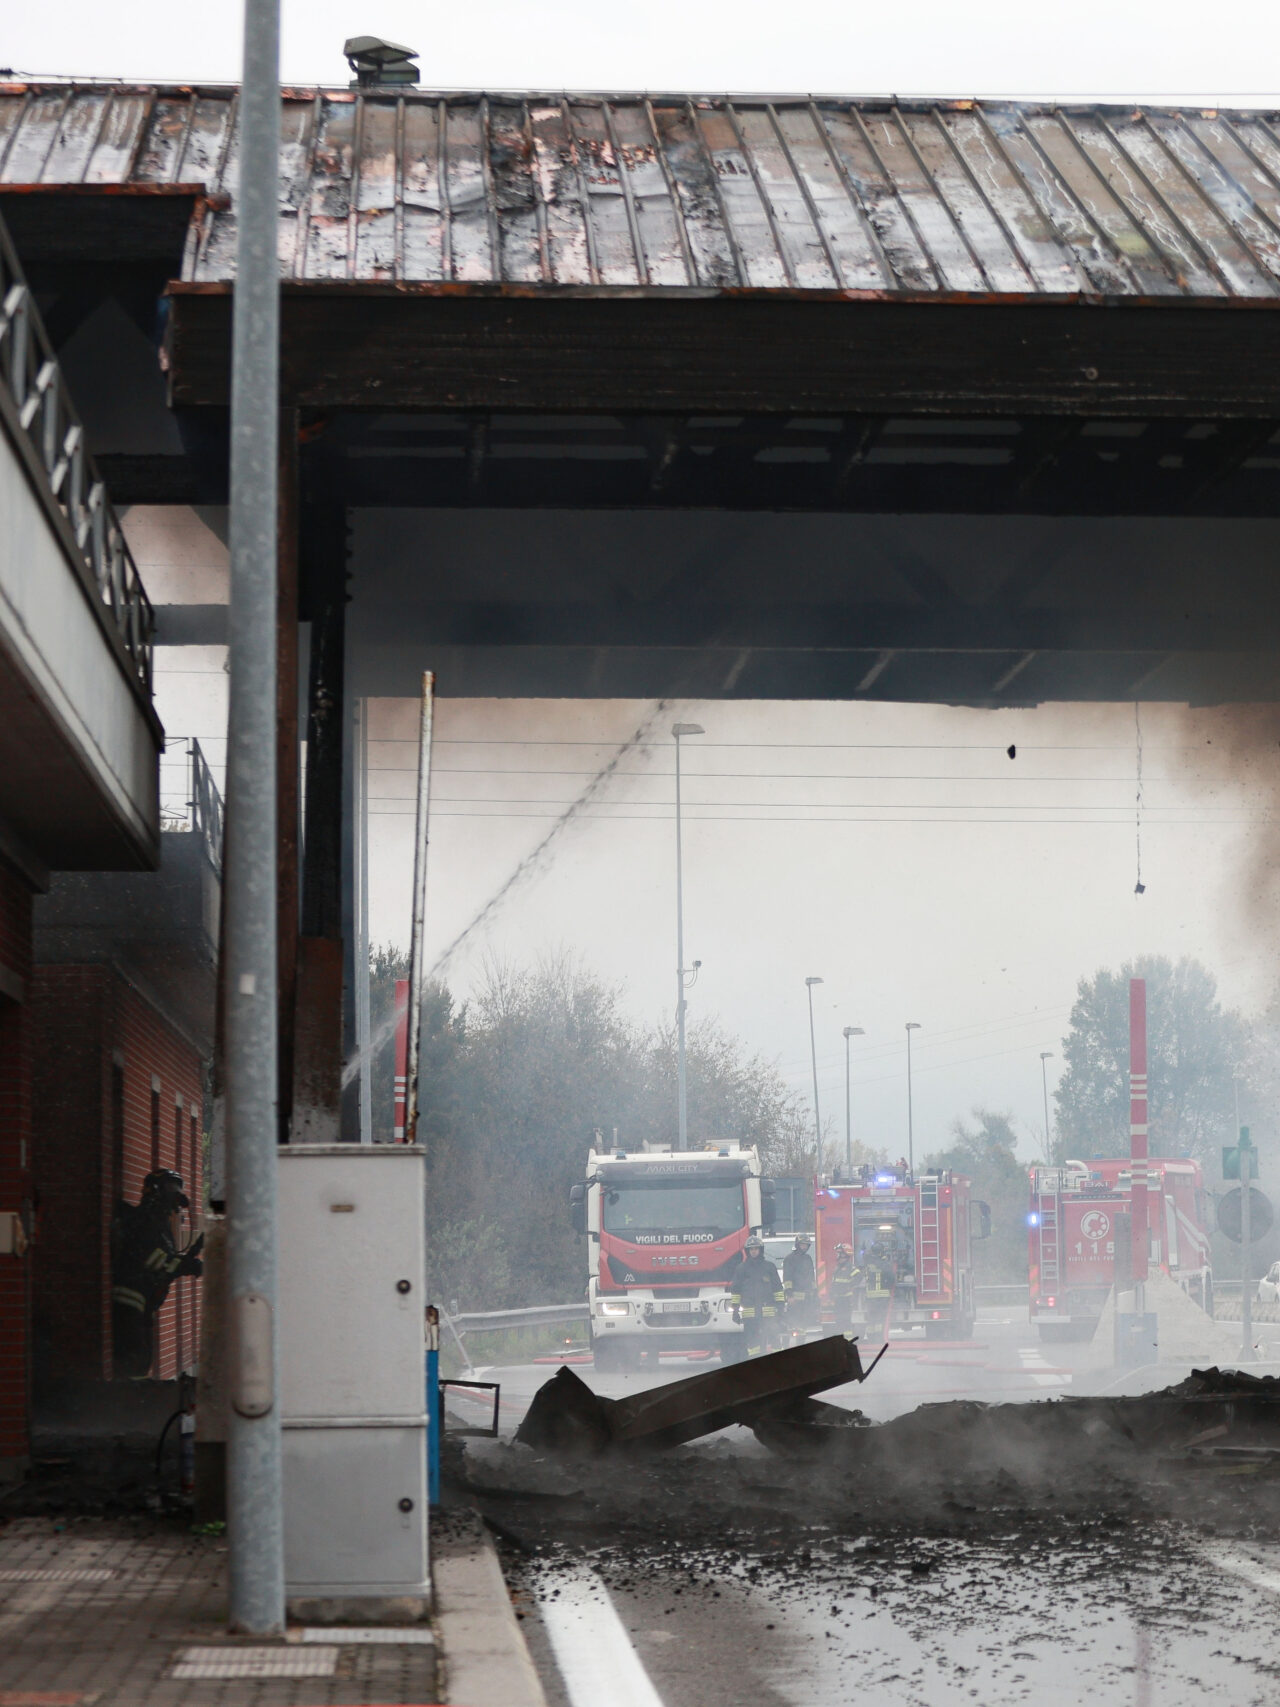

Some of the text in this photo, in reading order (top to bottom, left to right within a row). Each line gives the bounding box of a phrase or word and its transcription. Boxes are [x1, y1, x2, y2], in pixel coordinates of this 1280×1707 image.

[646, 1164, 699, 1174] MAXI CITY
[635, 1233, 714, 1244] VIGILI DEL FUOCO
[651, 1255, 699, 1267] IVECO
